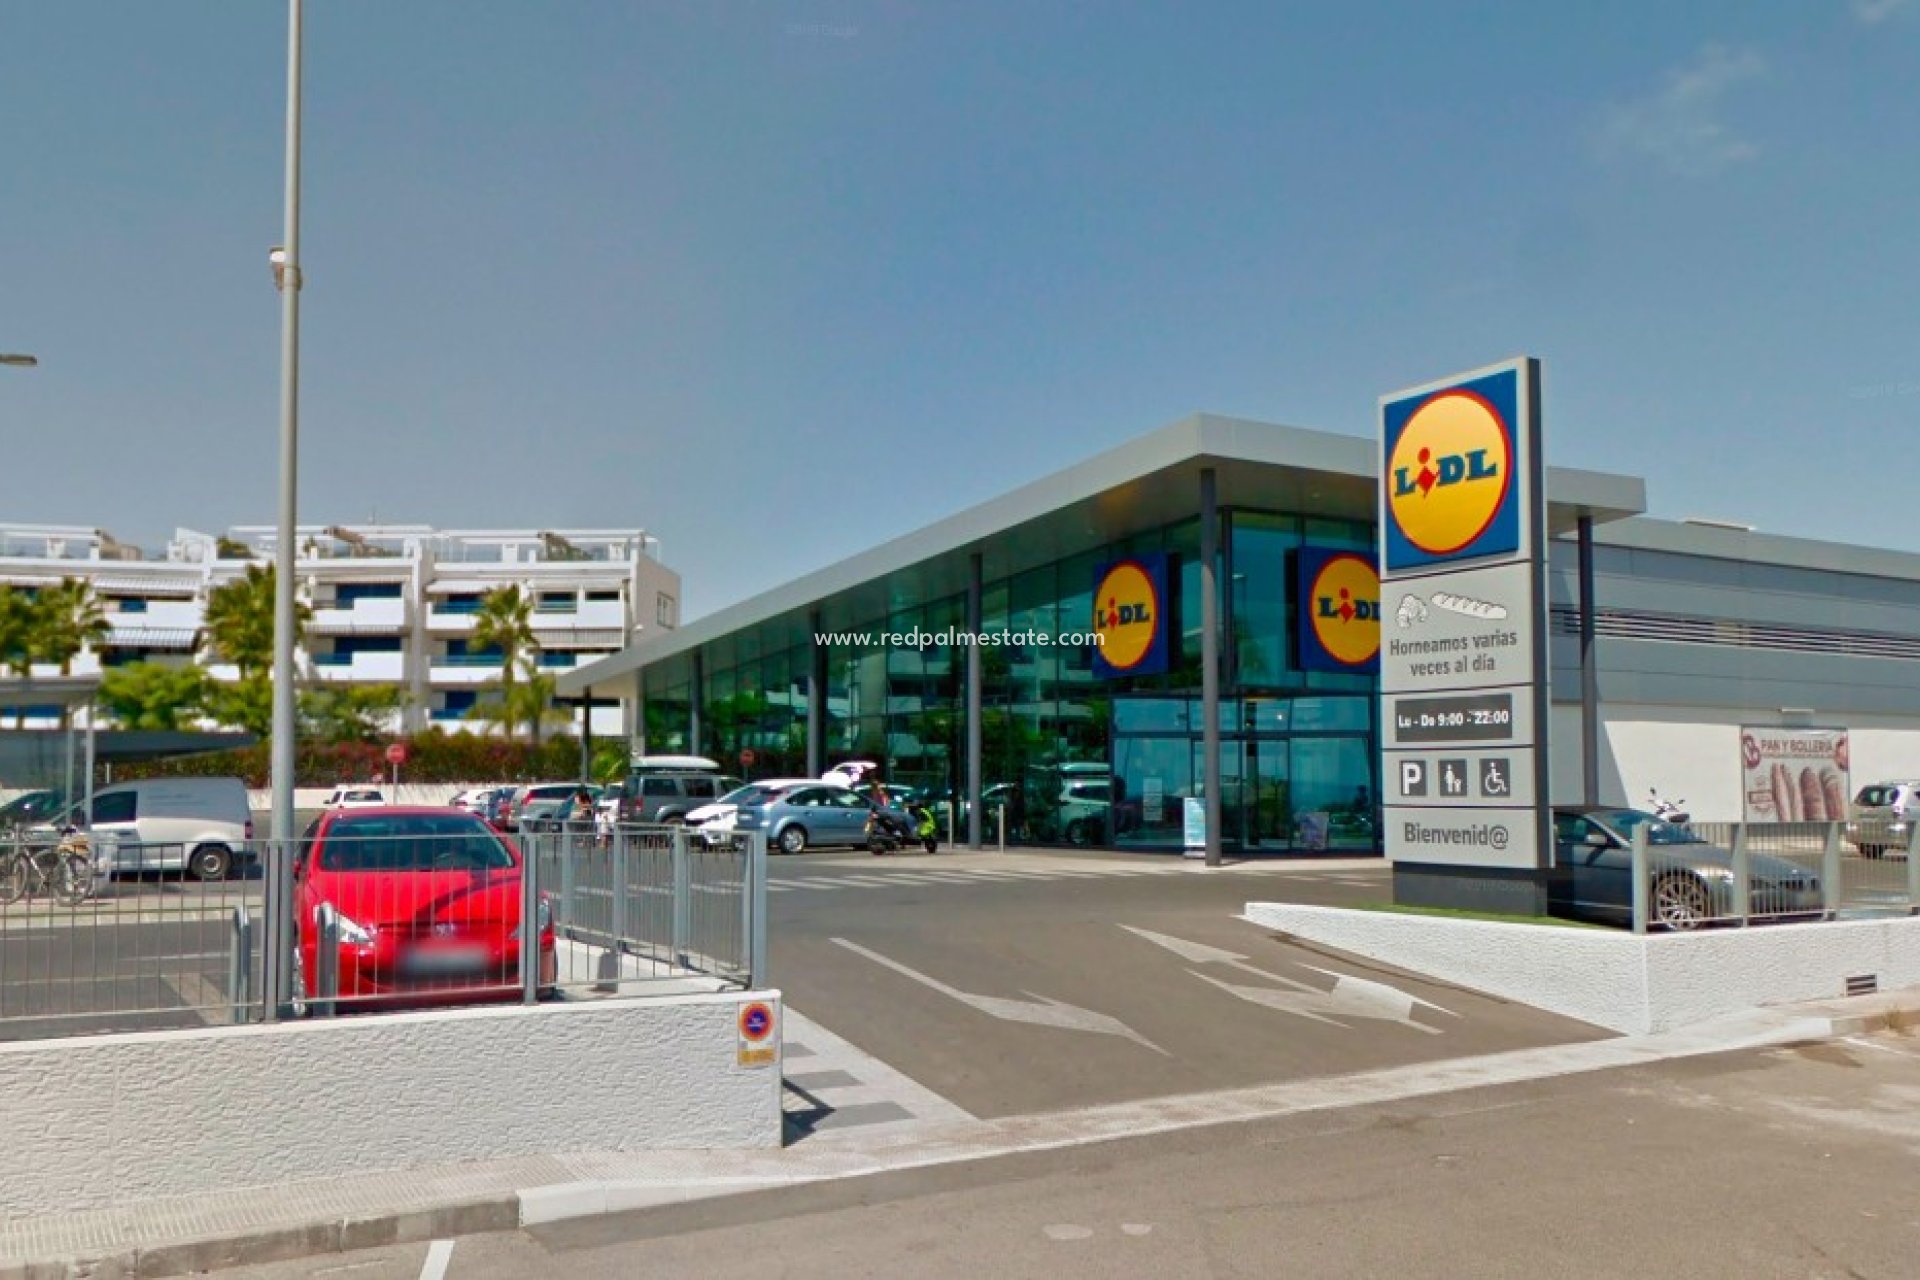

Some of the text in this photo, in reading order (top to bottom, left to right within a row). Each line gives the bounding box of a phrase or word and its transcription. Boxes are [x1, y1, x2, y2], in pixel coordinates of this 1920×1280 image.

[1390, 629, 1517, 656] Horneamos varias
[1410, 653, 1495, 676] veces al día
[1437, 712, 1464, 727] 9:00
[1402, 763, 1421, 794] P
[1404, 822, 1509, 850] Bienvenid@
